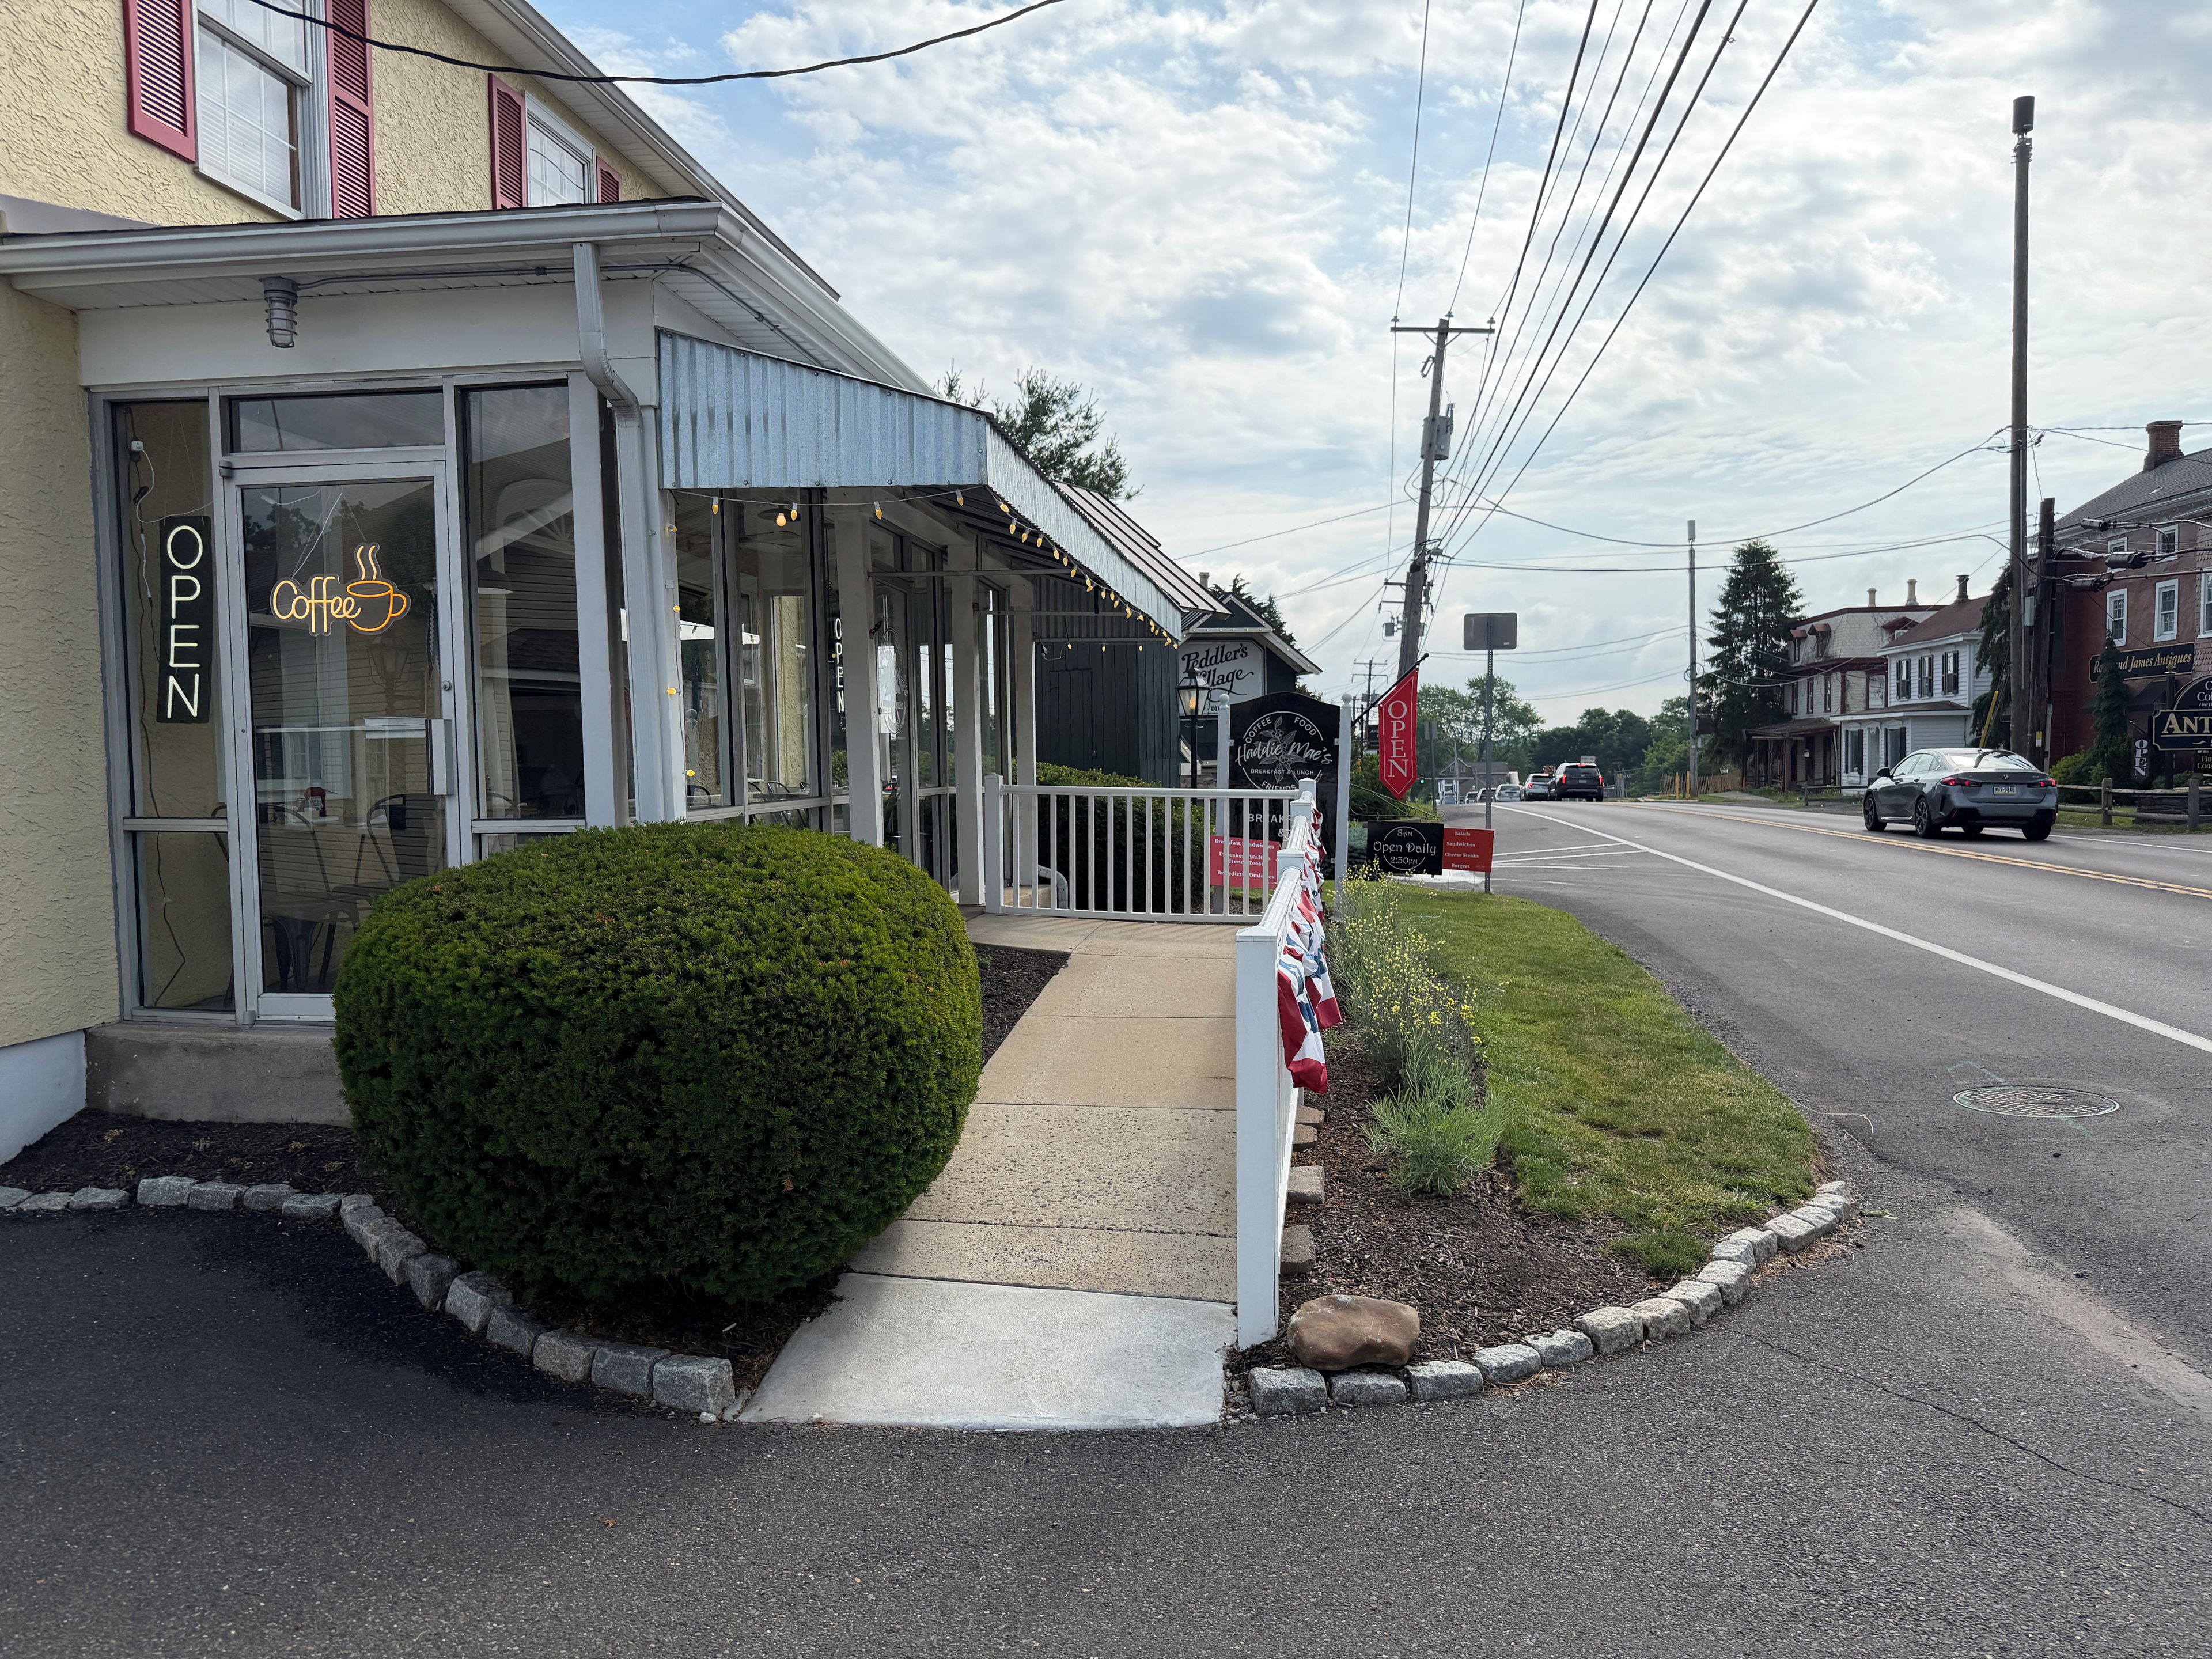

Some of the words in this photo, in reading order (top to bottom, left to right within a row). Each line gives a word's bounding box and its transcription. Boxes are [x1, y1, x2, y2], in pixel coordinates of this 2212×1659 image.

[273, 577, 361, 633] Coffee
[167, 525, 203, 718] OPEN
[835, 618, 844, 713] OPEN
[1181, 643, 1248, 673] Peddler's
[2128, 656, 2153, 672] James
[1245, 717, 1271, 744] COFFEE
[1294, 717, 1316, 736] FOOD
[1388, 700, 1408, 777] OPEN
[1235, 740, 1282, 766] Haddie
[1288, 742, 1332, 765] Mae's
[2134, 740, 2148, 776] OPEN
[1373, 841, 1402, 854] Open
[1406, 842, 1437, 856] Daily
